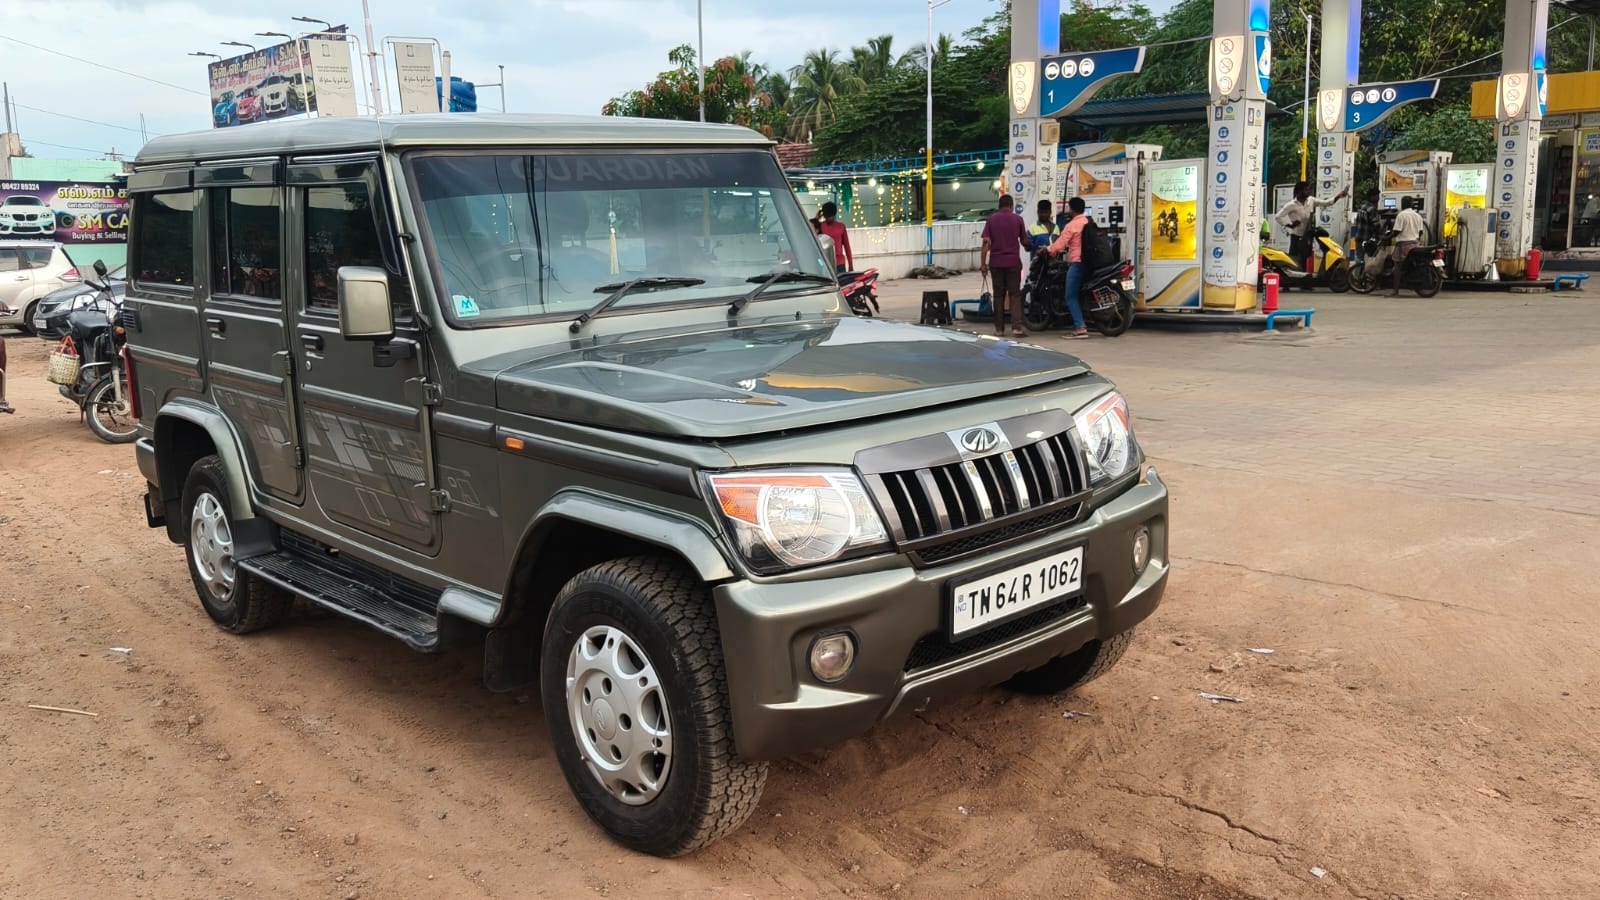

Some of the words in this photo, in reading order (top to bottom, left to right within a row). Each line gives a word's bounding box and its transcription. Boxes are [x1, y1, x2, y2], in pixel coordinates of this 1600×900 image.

[1047, 89, 1054, 104] 1
[1353, 111, 1360, 123] 3
[510, 155, 714, 182] GUARDIAN
[78, 214, 103, 229] SM
[107, 214, 129, 229] CA
[72, 232, 95, 240] Buying
[104, 231, 127, 240] Selling
